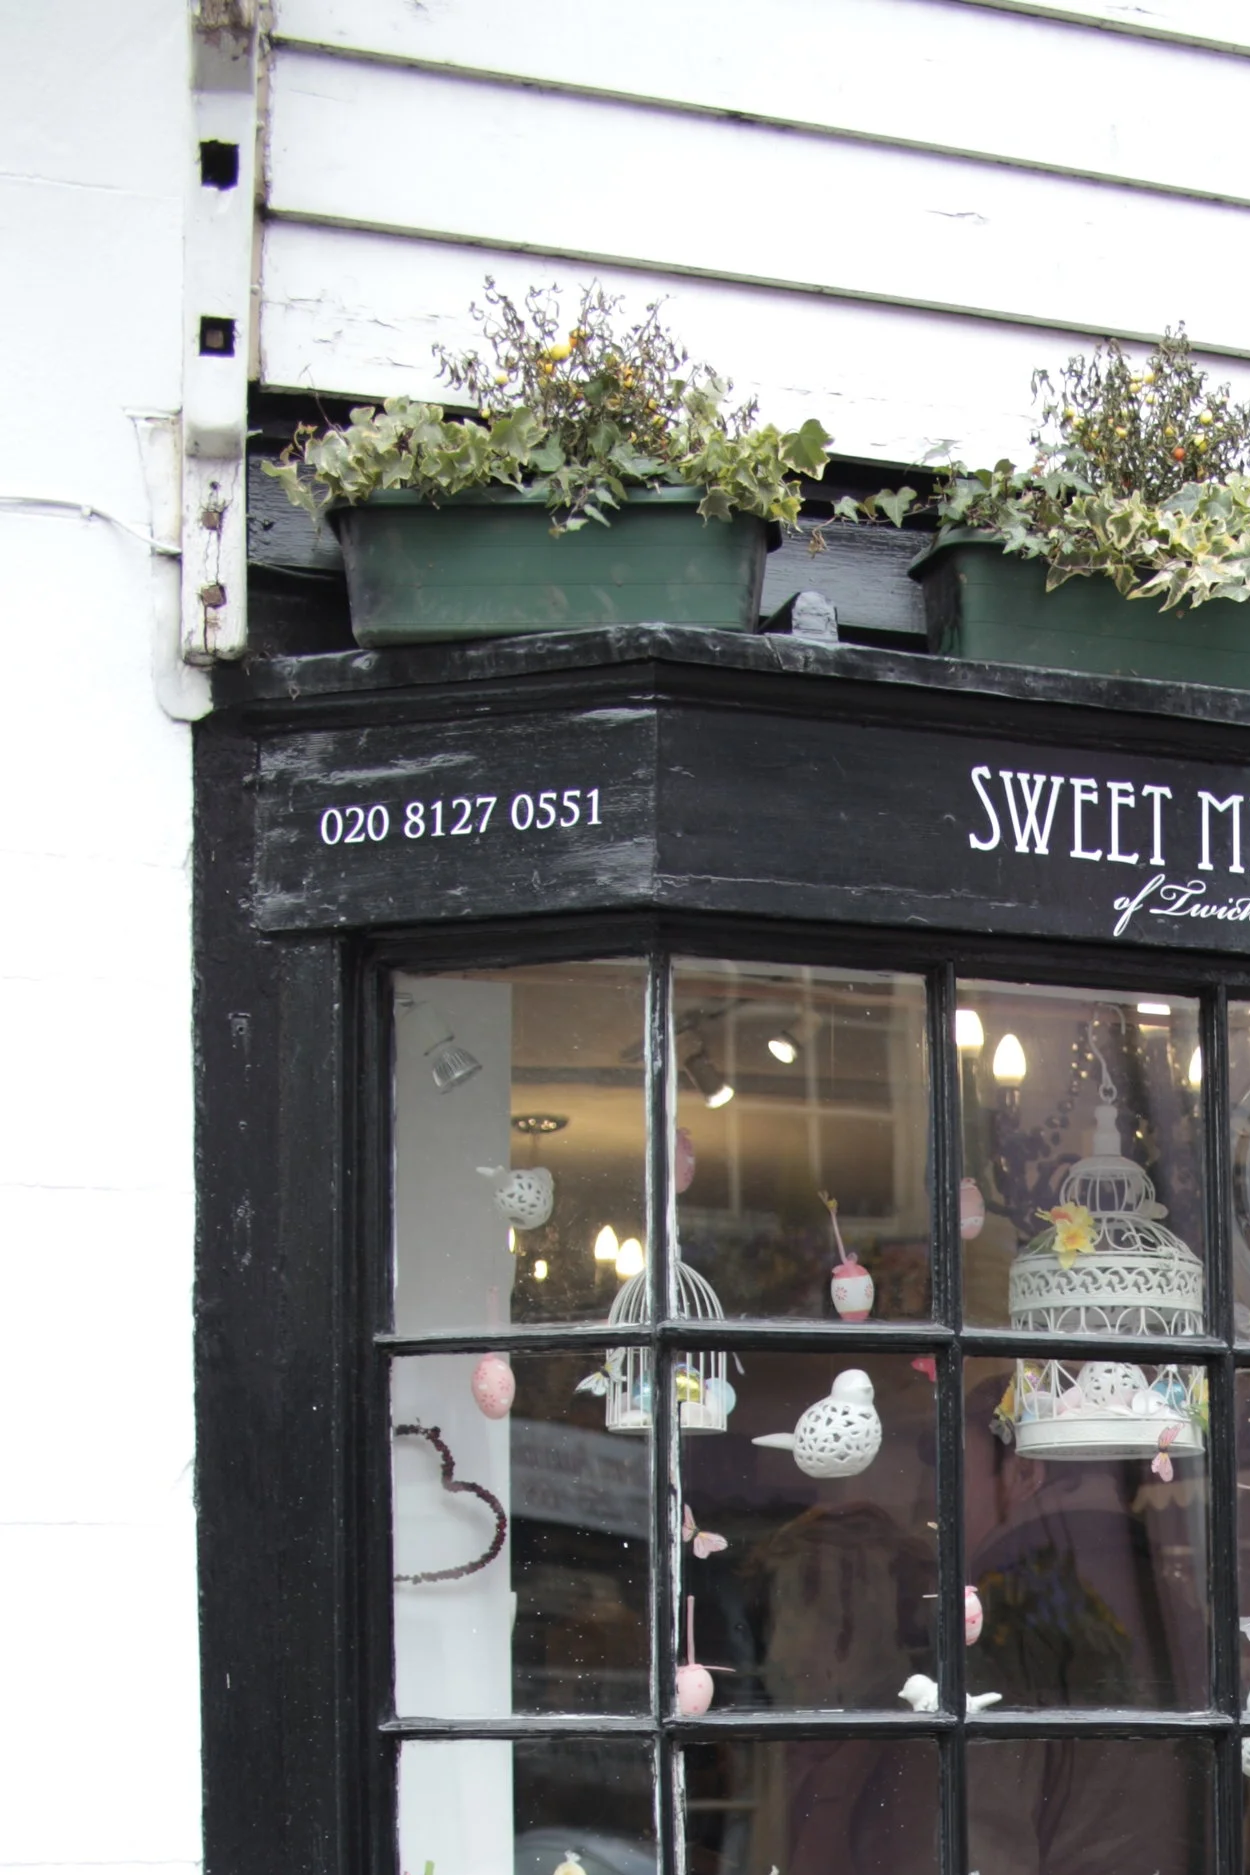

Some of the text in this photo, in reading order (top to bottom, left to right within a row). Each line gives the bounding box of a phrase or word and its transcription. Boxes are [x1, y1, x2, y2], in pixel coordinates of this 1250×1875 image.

[320, 789, 602, 845] 020 8127 0551
[968, 766, 1173, 866] SWEET
[1112, 874, 1166, 937] of
